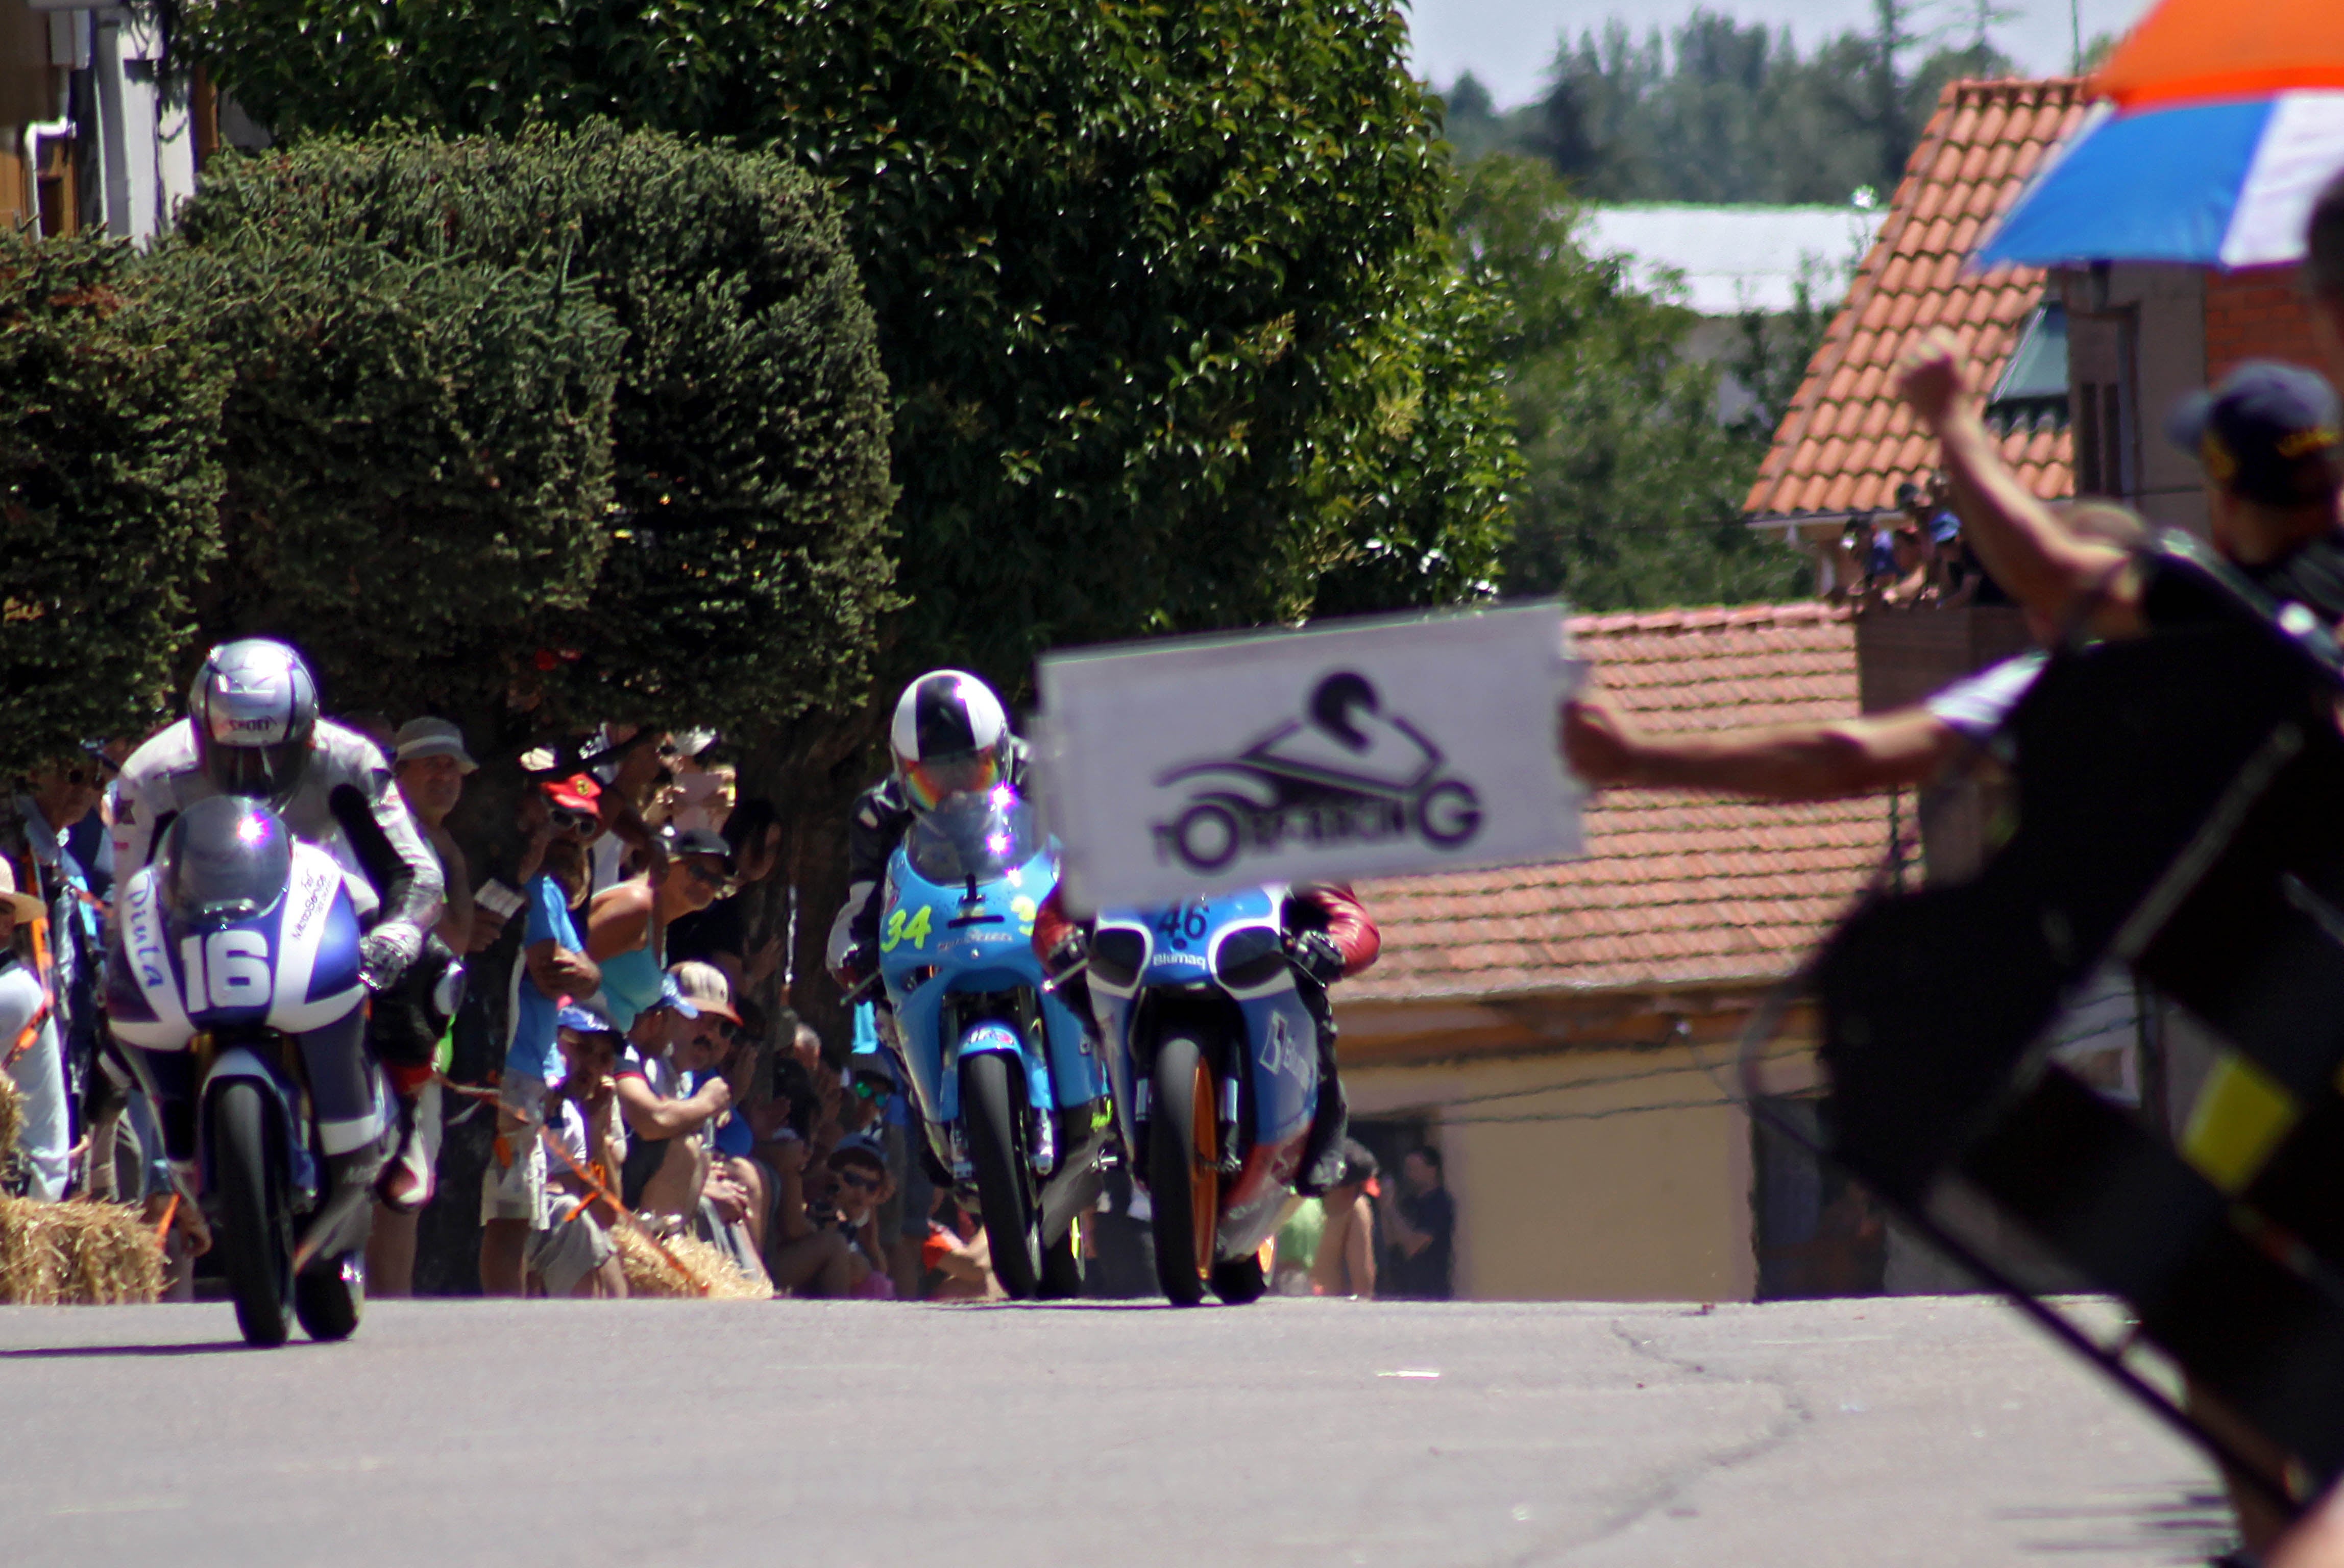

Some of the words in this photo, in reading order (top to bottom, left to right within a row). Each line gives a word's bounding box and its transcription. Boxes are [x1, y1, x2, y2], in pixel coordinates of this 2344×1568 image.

[881, 904, 932, 953] 34
[1157, 898, 1210, 941] 46
[181, 929, 271, 1013] 16
[1153, 953, 1206, 970] Blumaq
